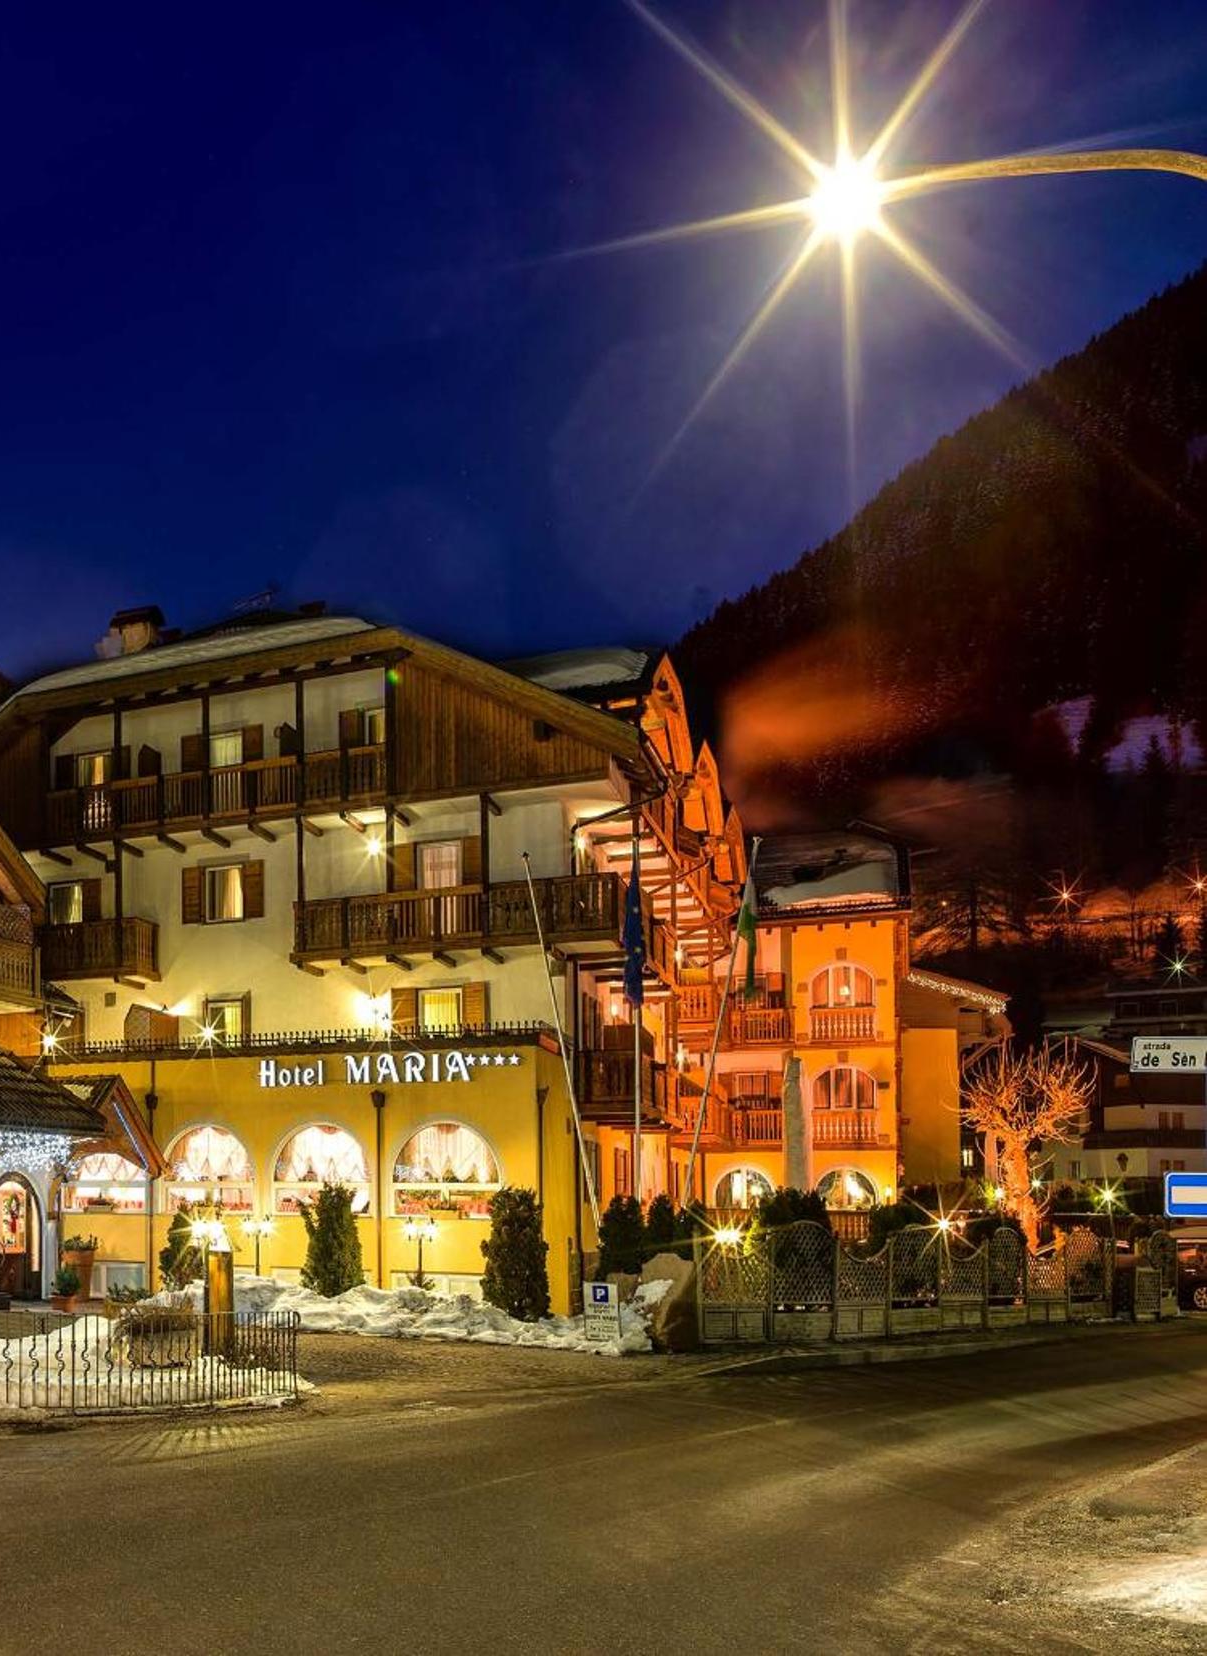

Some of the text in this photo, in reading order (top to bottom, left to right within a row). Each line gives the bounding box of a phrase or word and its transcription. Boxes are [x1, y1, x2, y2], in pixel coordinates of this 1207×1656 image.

[1143, 1042, 1171, 1050] strada
[1141, 1052, 1160, 1067] de
[1171, 1051, 1196, 1067] Sèn
[259, 1051, 470, 1087] Hotel MARIA
[596, 1288, 605, 1300] P
